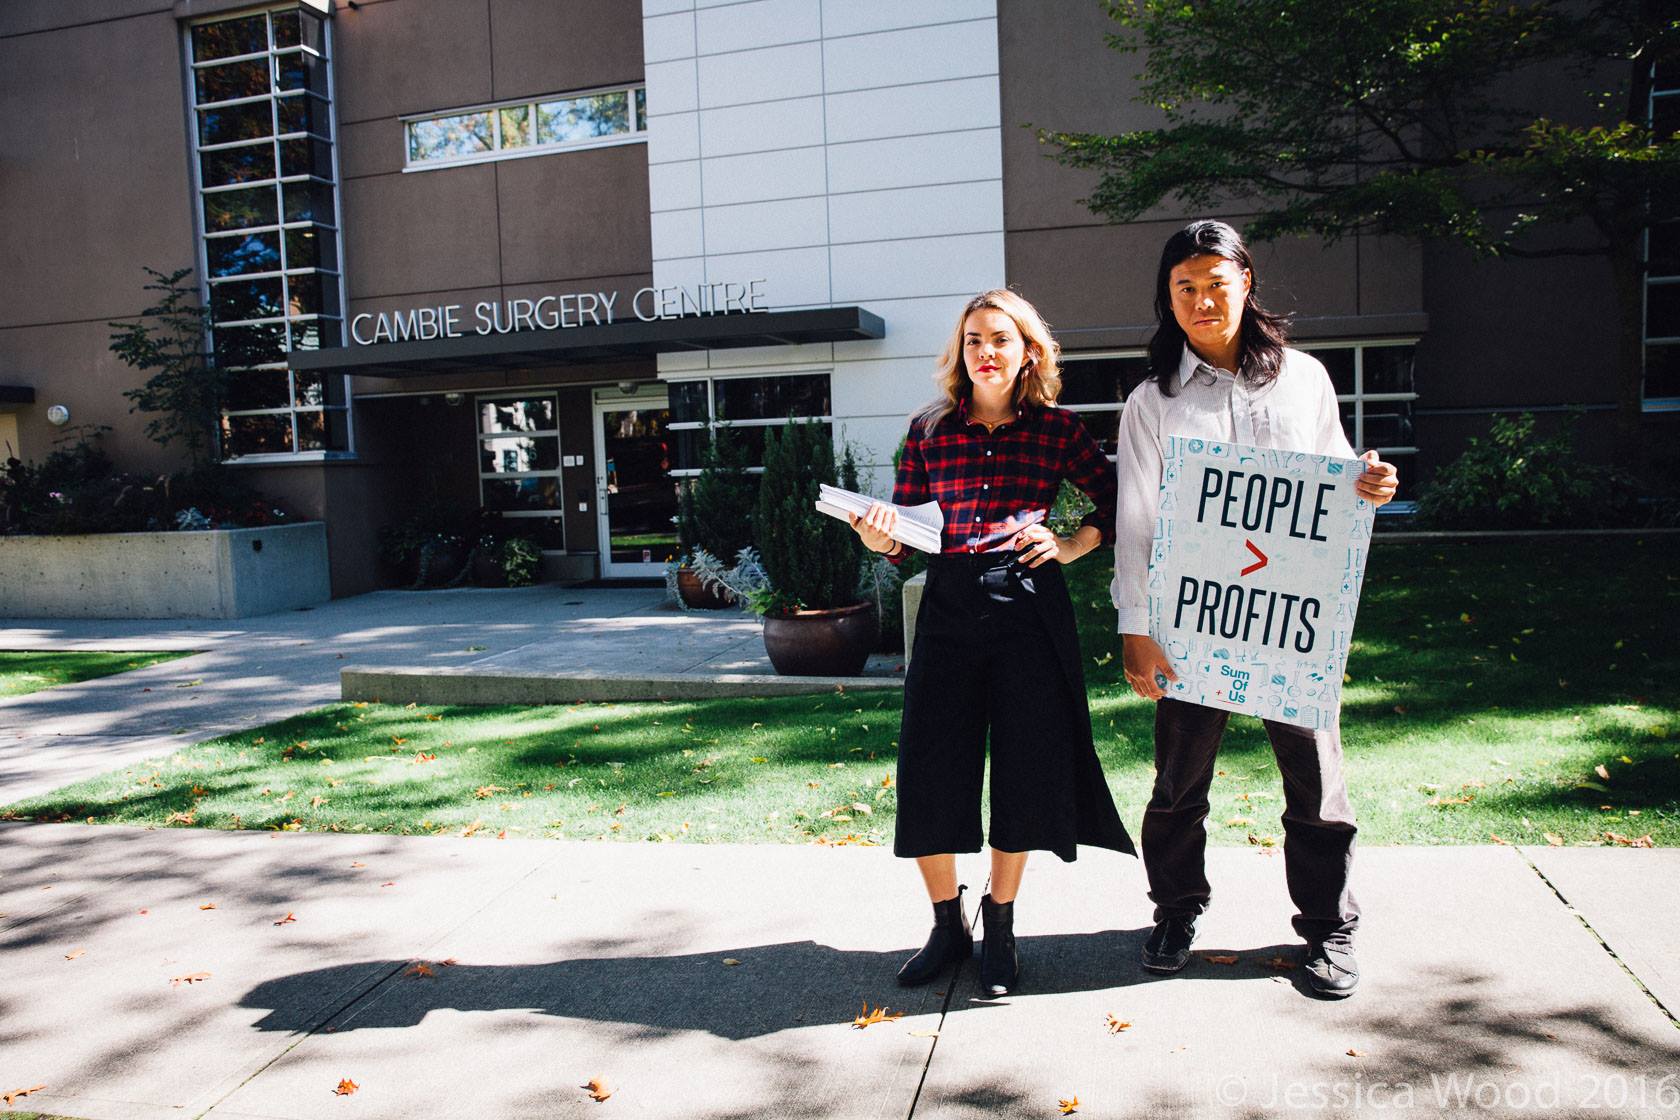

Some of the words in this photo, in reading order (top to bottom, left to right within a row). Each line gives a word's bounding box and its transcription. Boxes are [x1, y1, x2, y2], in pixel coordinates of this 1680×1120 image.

[351, 305, 462, 345] CAMBIE
[475, 291, 617, 335] SURGERY
[632, 280, 768, 322] CENTRE
[1197, 467, 1335, 542] PEOPLE
[1174, 576, 1320, 654] PROFITS
[1221, 665, 1250, 680] Sum
[1232, 679, 1248, 691] Of
[1228, 690, 1246, 703] Us
